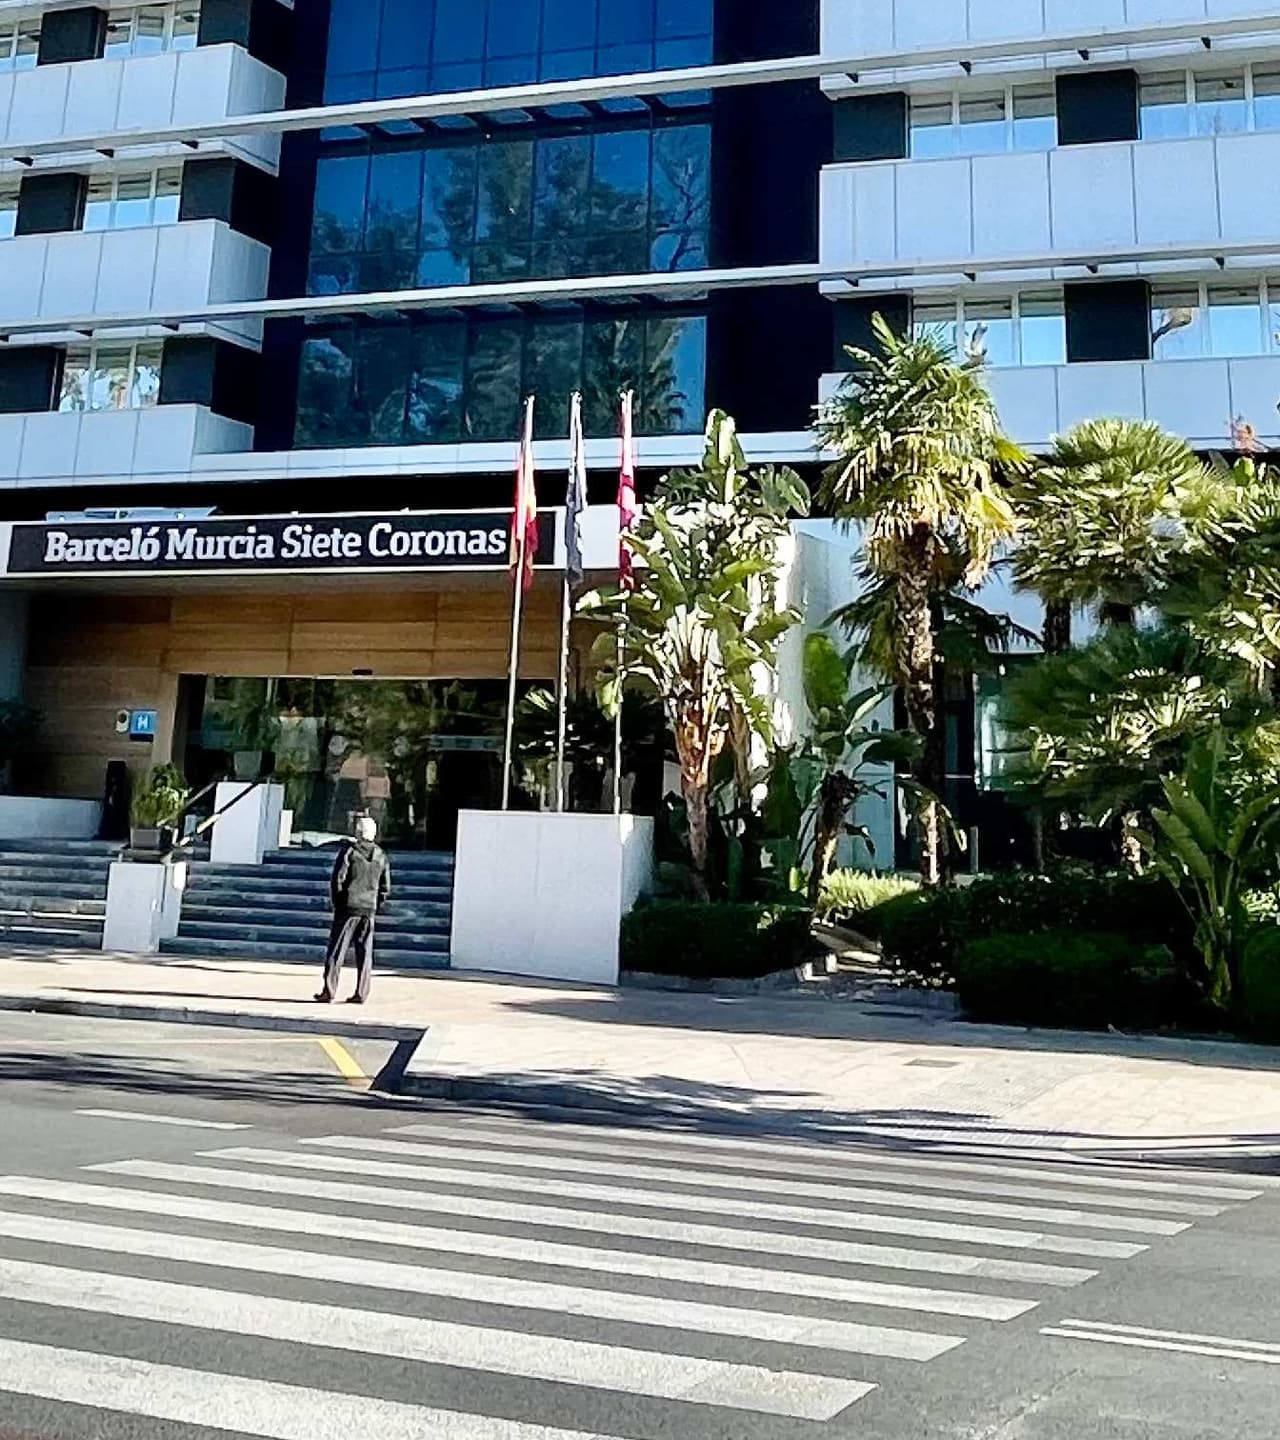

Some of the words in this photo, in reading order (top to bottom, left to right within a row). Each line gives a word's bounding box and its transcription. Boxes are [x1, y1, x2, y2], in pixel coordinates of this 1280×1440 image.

[43, 526, 160, 563] Barceló
[166, 525, 276, 561] Murcia
[281, 523, 361, 558] Siete
[368, 522, 507, 557] Coronas
